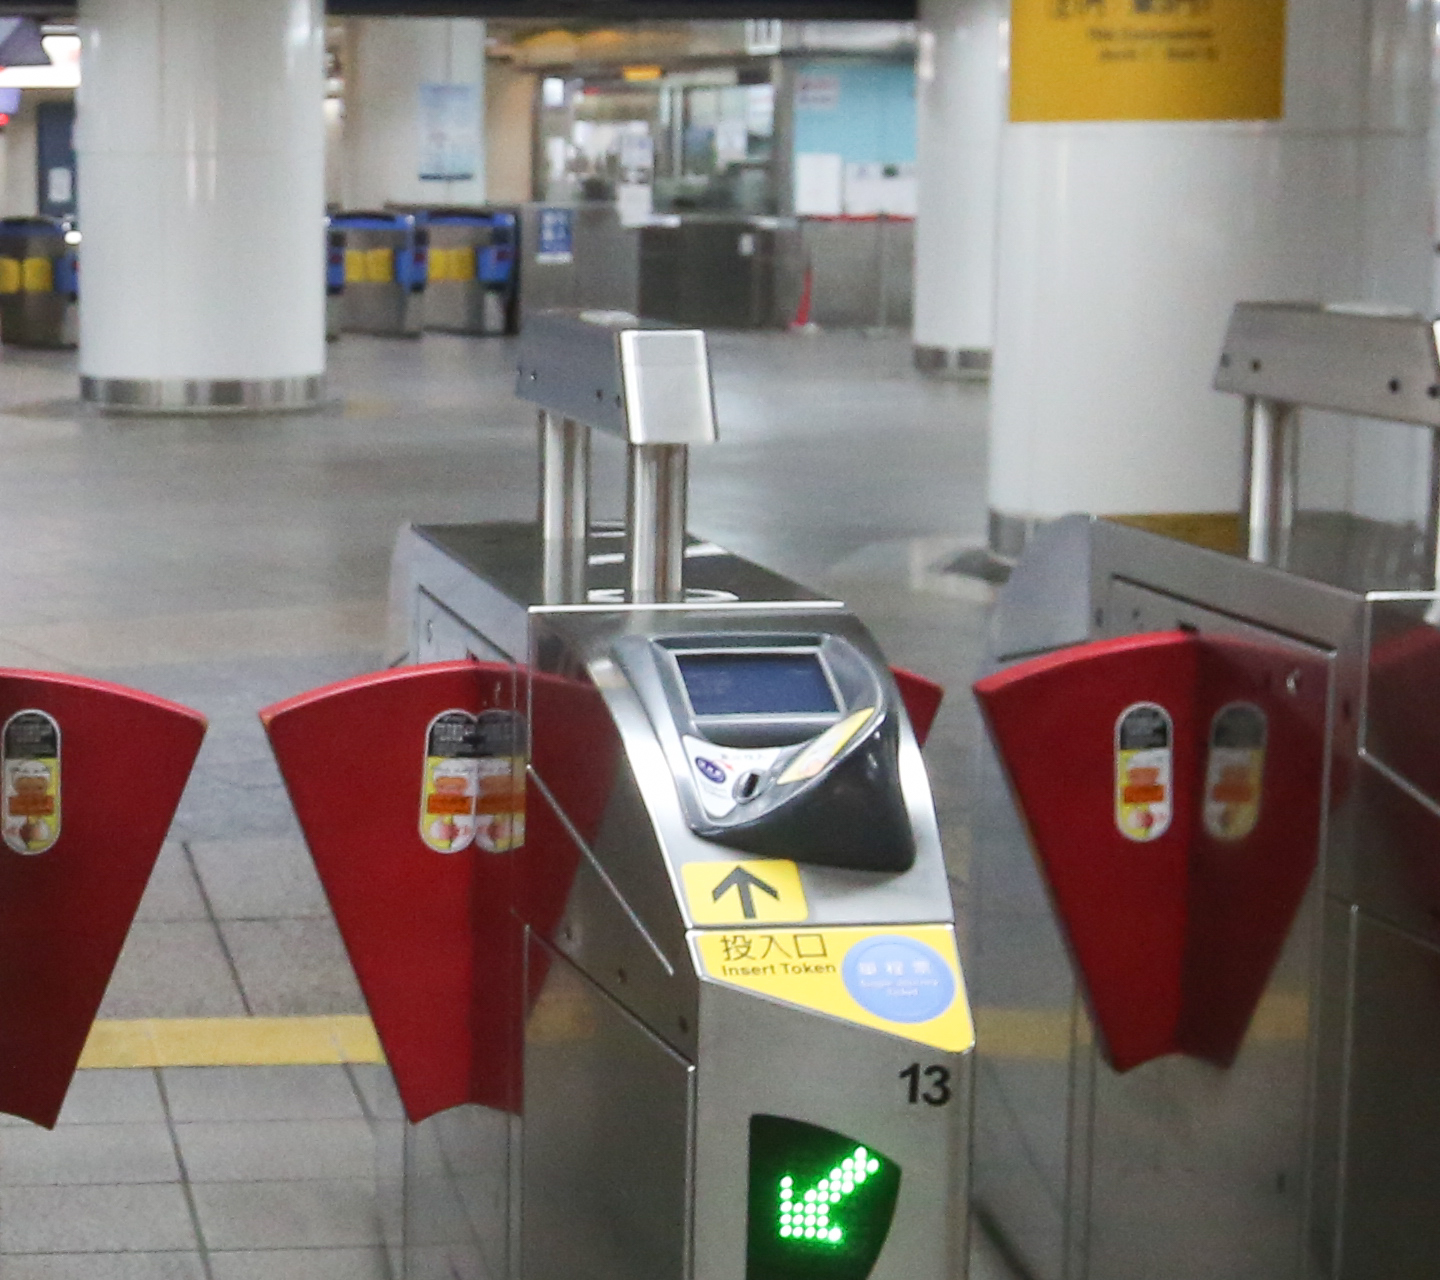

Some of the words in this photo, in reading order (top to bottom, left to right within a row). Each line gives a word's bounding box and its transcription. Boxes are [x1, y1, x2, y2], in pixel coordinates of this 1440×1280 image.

[721, 933, 828, 961] 投入口
[722, 964, 775, 977] Insert
[784, 963, 836, 974] Token
[899, 1063, 951, 1107] 13
